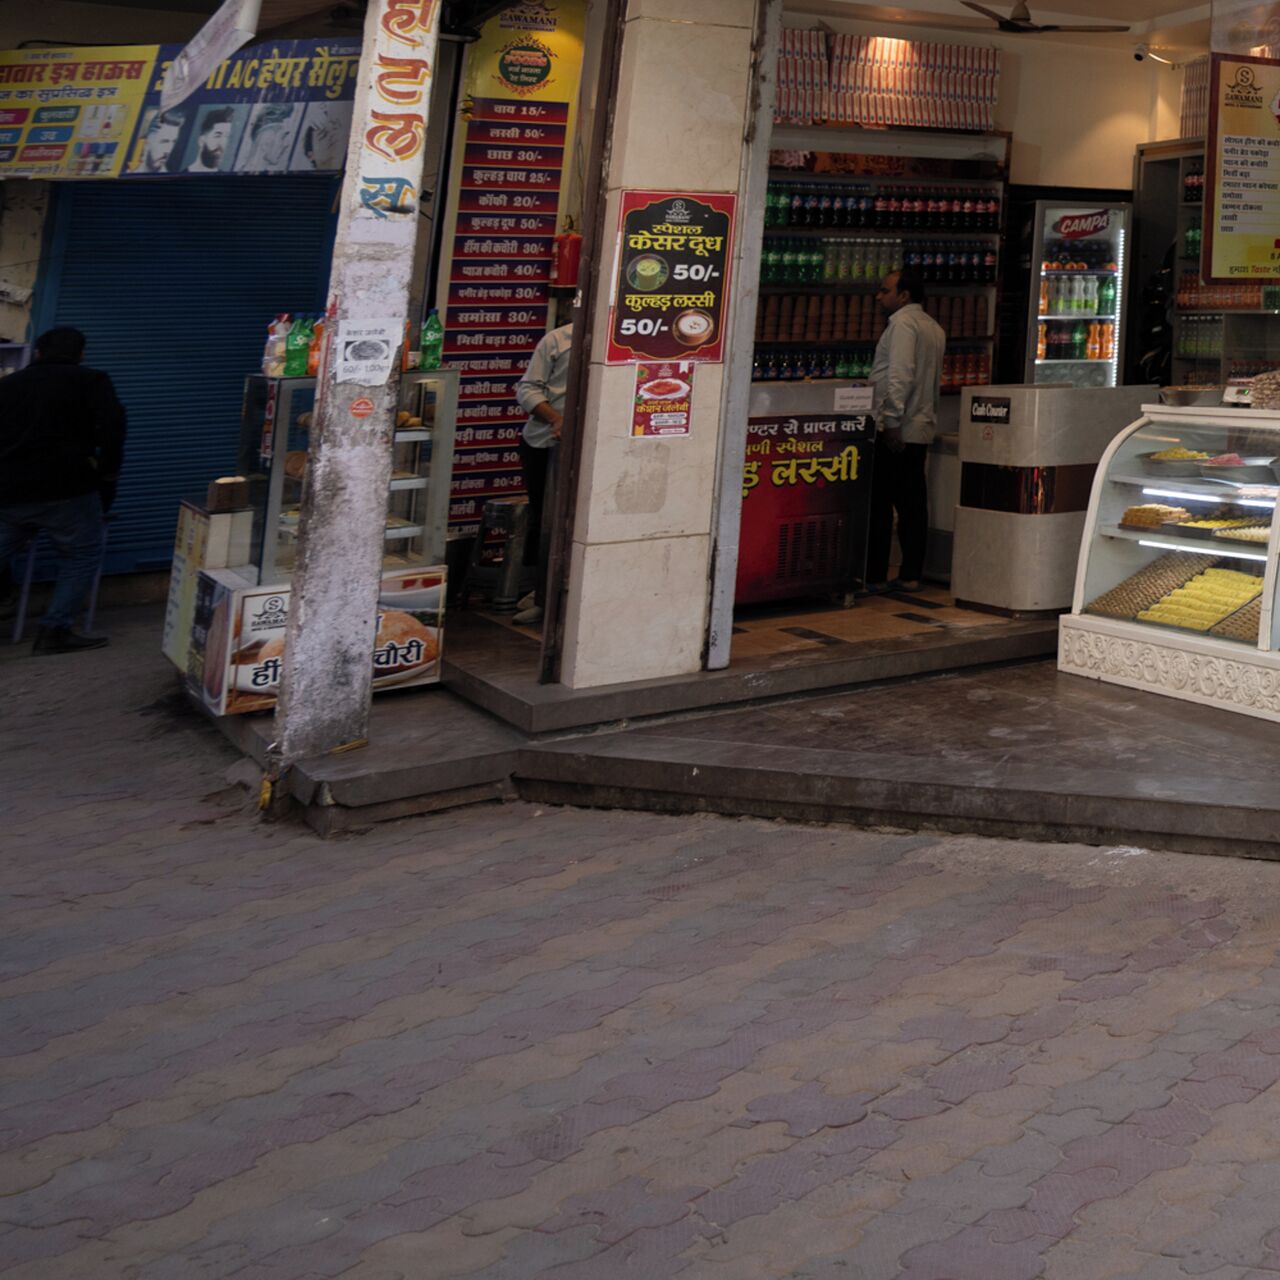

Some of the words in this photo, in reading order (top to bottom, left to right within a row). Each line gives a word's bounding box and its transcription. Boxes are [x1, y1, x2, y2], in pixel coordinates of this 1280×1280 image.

[257, 48, 304, 87] हेयर
[494, 104, 516, 115] चाय
[520, 106, 547, 117] 15/-
[523, 128, 545, 139] 50/-
[516, 150, 543, 162] 30/-
[529, 172, 552, 184] 25/-
[513, 196, 541, 209] 20/-
[520, 218, 543, 230] 50/-
[652, 222, 703, 235] स्पेशल
[1061, 214, 1108, 234] CAMPA
[522, 242, 545, 255] 30/-
[628, 231, 685, 253] केसर
[688, 233, 724, 257] दूध
[513, 264, 542, 277] 40/-
[672, 263, 720, 283] 50/-
[515, 287, 541, 299] 30/-
[625, 292, 673, 313] कुल्हड़
[673, 290, 716, 309] लस्सी
[457, 309, 502, 323] समोसा
[507, 311, 537, 324] 30/-
[619, 318, 669, 337] 50/-
[508, 334, 533, 346] 30/-
[783, 419, 799, 435] से
[803, 420, 837, 434] प्राप्त
[840, 416, 867, 432] करें
[775, 437, 824, 454] स्पेशल
[770, 444, 862, 487] लस्सी
